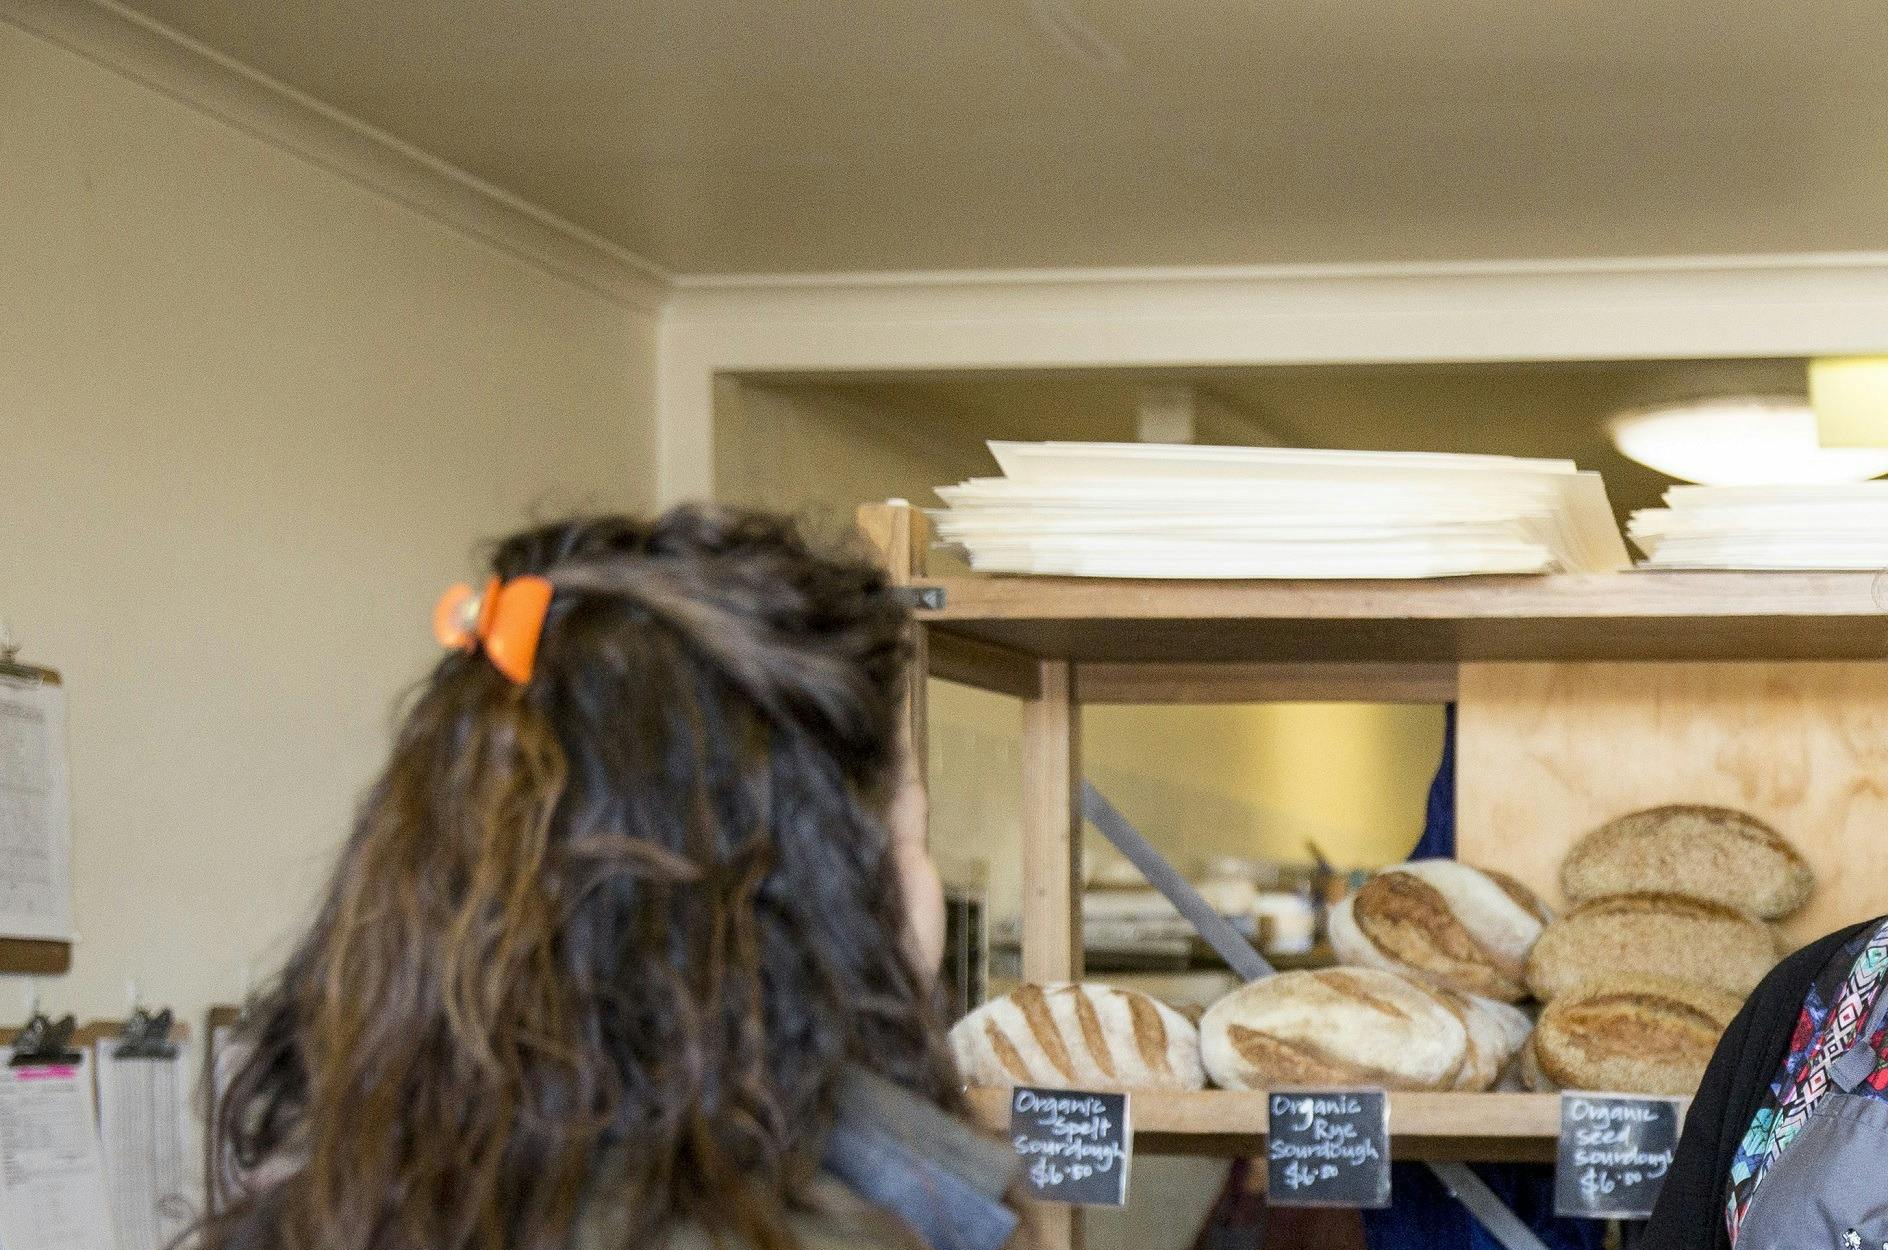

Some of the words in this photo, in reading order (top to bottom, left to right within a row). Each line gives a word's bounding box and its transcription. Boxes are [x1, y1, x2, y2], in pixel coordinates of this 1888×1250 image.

[1014, 1090, 1107, 1125] Organic
[1272, 1095, 1362, 1131] Organic
[1571, 1100, 1659, 1130] Organic
[1314, 1118, 1358, 1146] Rye
